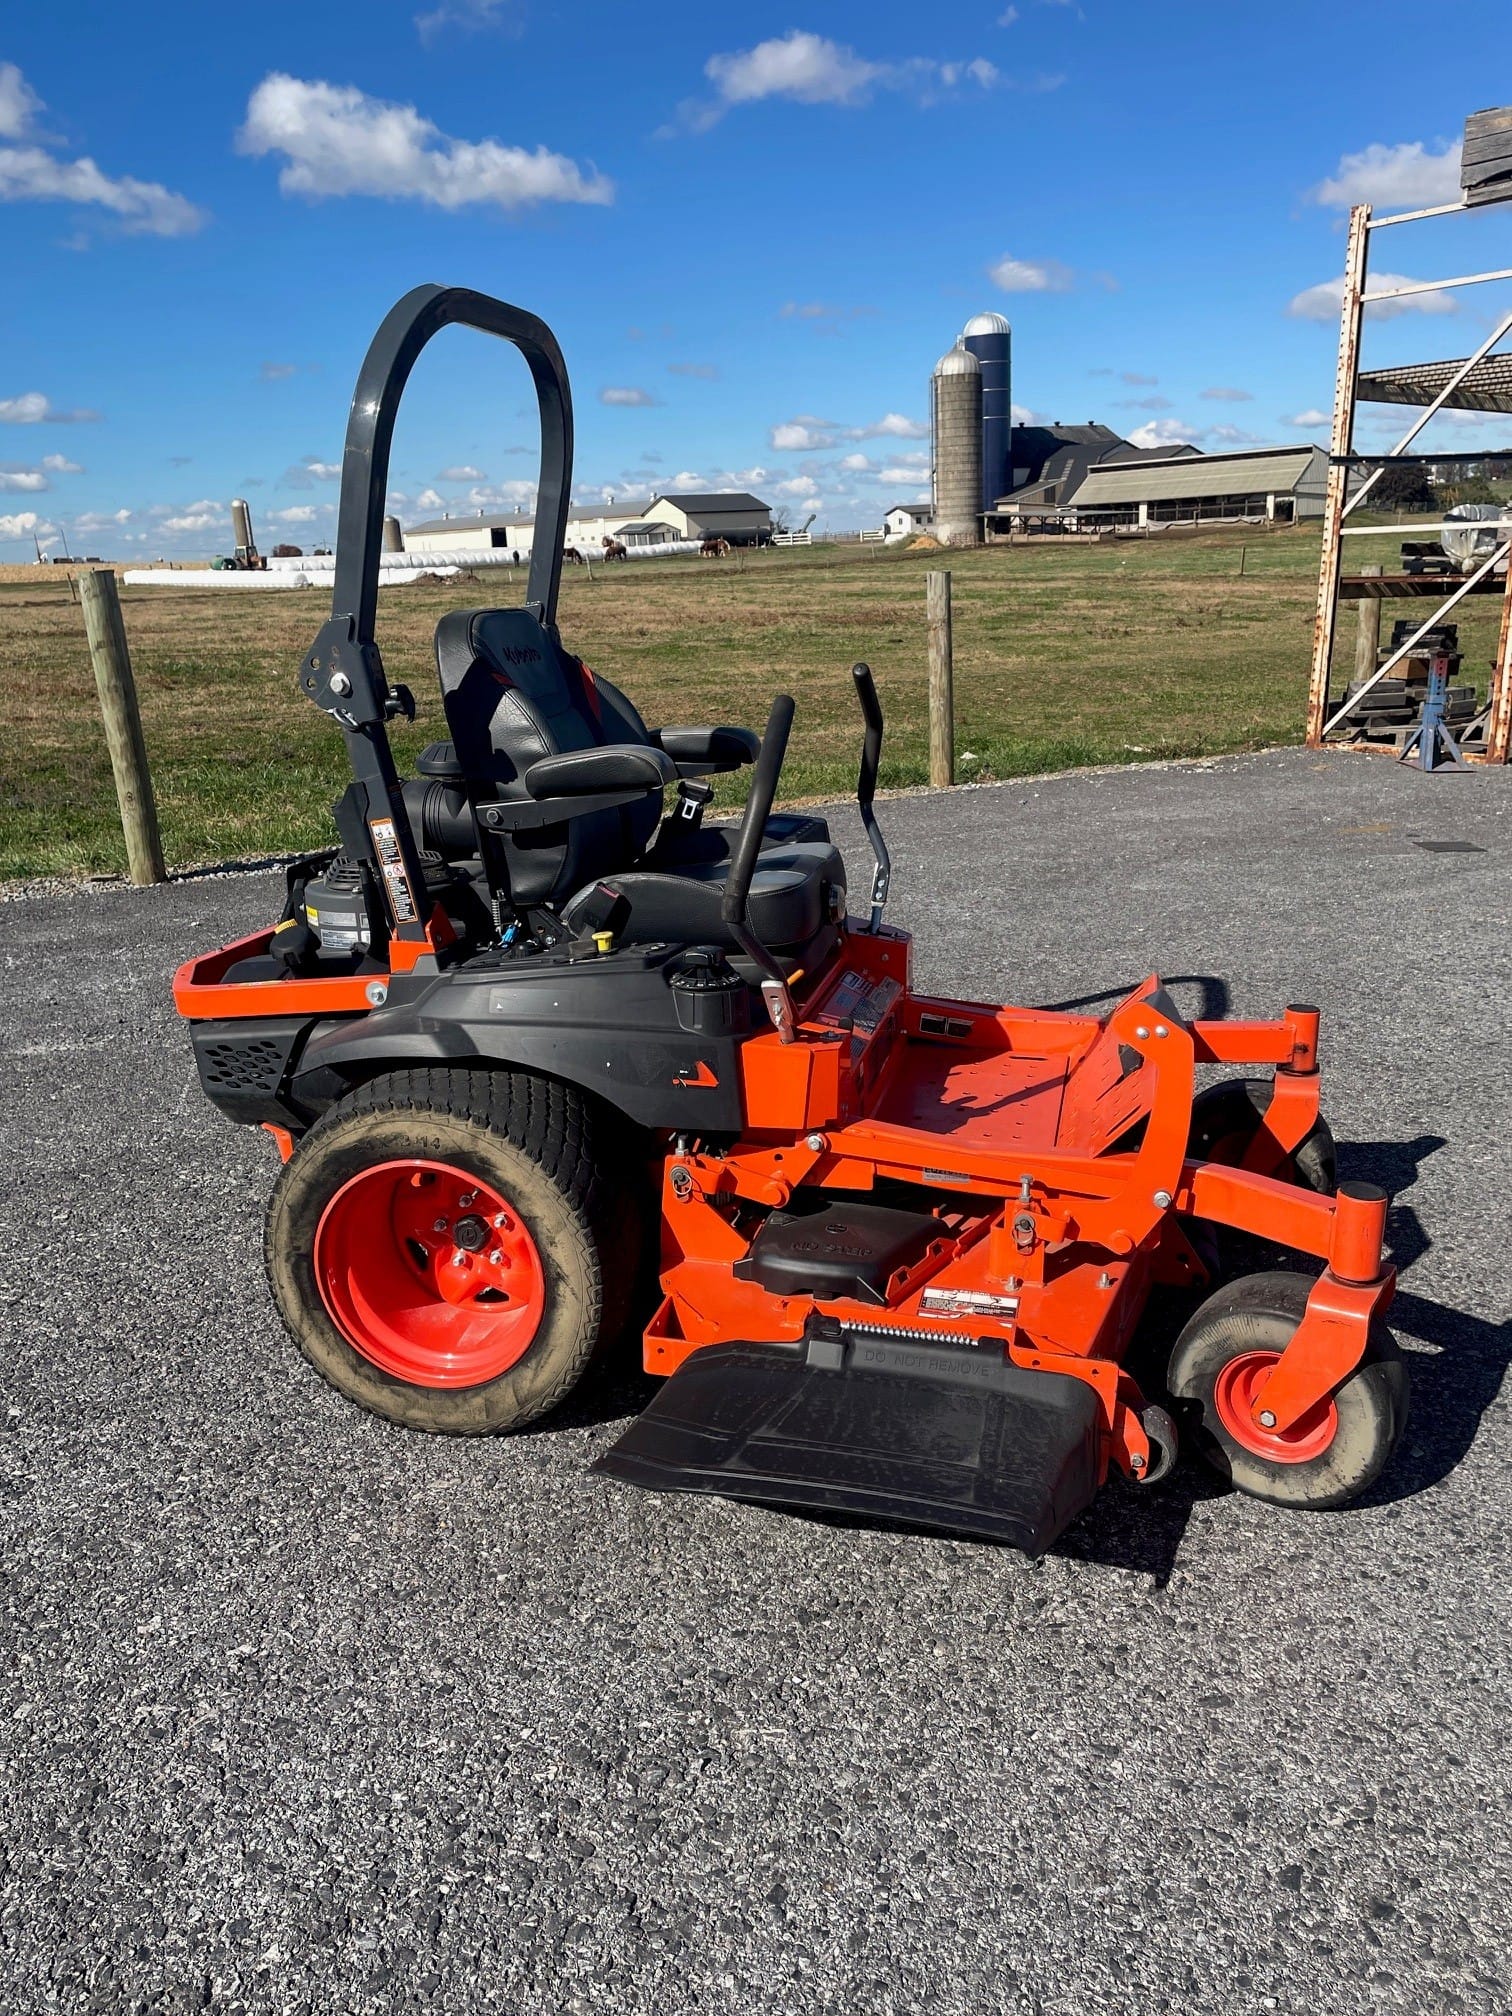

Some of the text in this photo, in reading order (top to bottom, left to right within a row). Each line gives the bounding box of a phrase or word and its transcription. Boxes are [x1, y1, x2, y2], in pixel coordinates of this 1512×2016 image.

[791, 1241, 873, 1257] NO STEP
[864, 1350, 990, 1377] DO NOT REMOVE
